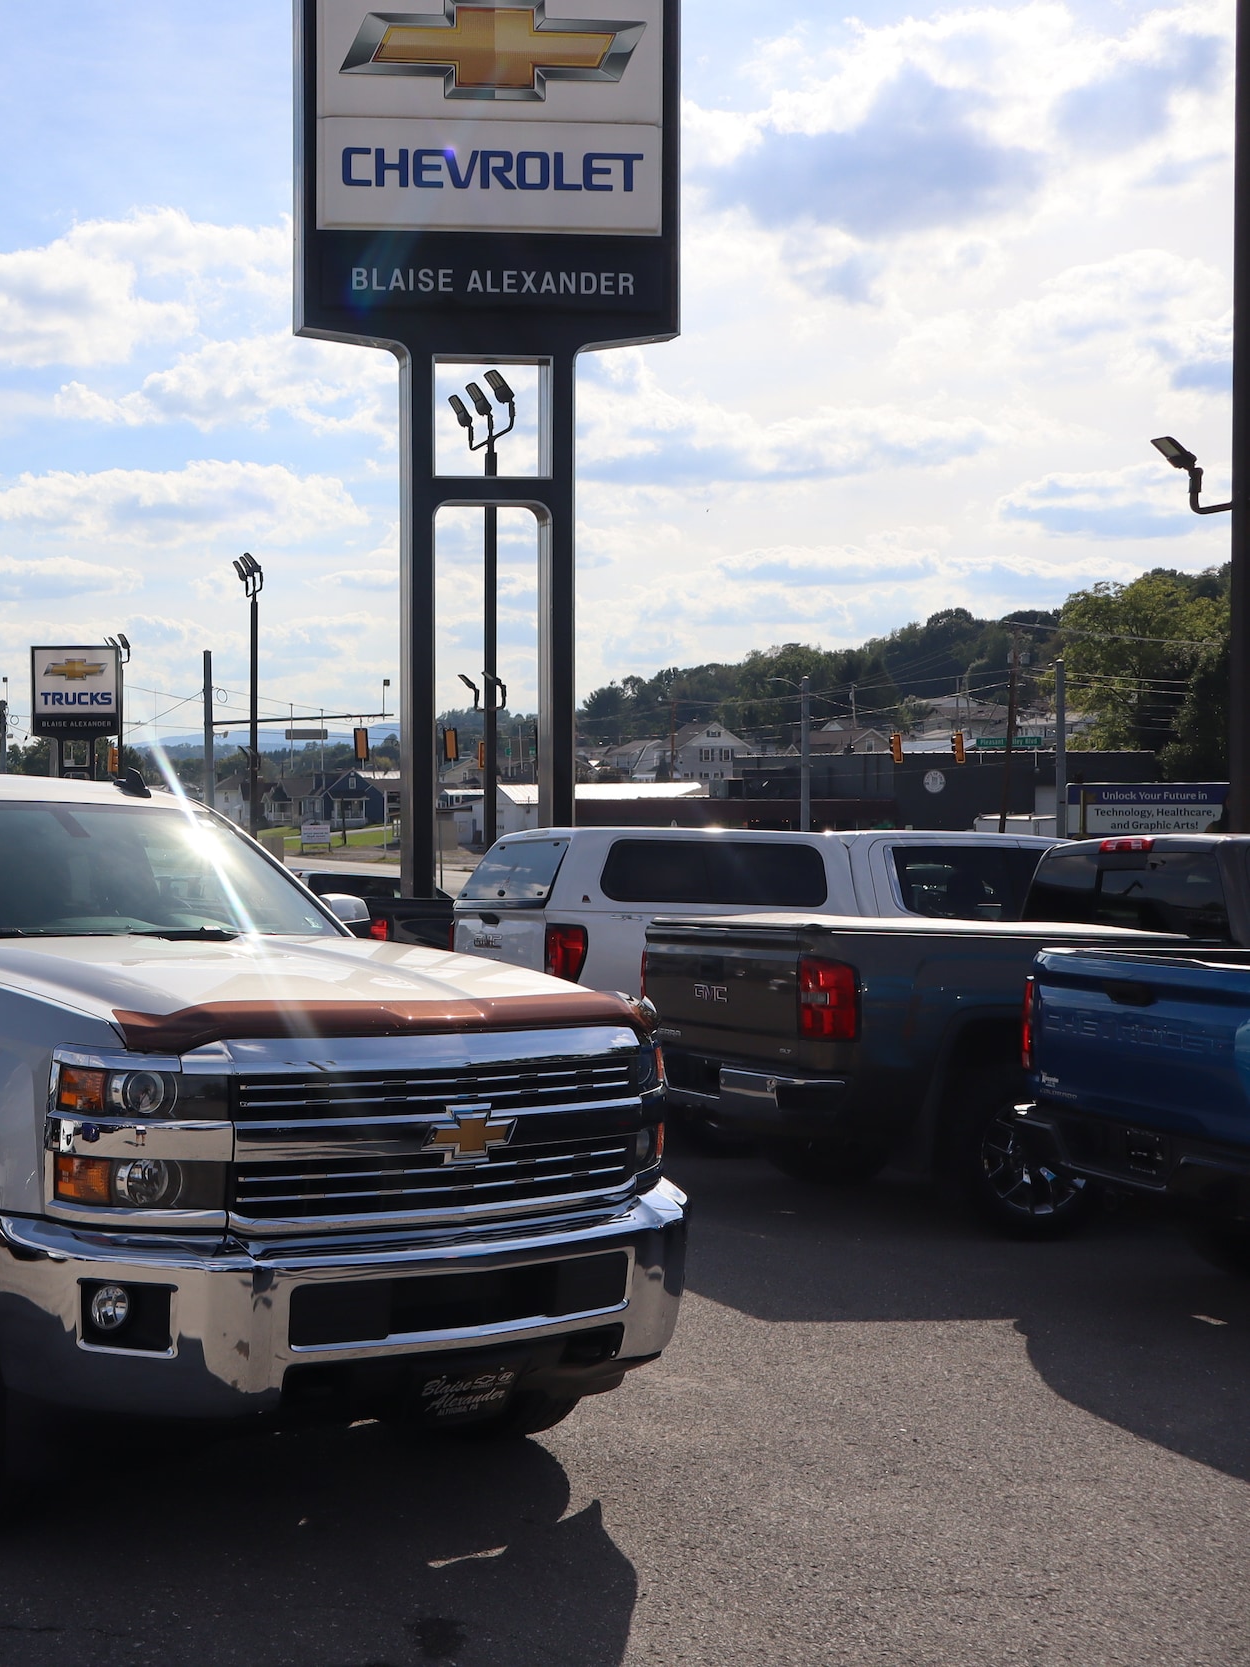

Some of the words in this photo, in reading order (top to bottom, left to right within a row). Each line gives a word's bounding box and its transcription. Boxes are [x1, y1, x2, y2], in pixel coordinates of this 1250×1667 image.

[342, 147, 643, 192] CHEVROLET
[351, 267, 454, 292] BLAISE
[466, 270, 635, 295] ALEXANDER
[40, 692, 112, 705] TRUCKS
[1102, 791, 1136, 800] Unlock
[1139, 791, 1160, 800] Your
[1163, 791, 1196, 800] Future
[1198, 791, 1207, 800] in
[1094, 808, 1154, 818] Technology,
[1157, 808, 1215, 818] Healthcare,
[1111, 821, 1129, 830] and
[1132, 821, 1171, 832] Graphic
[1174, 821, 1198, 830] Arts!
[694, 983, 727, 1002] GMC
[421, 1380, 473, 1397] Blaise
[425, 1388, 505, 1412] Alexander
